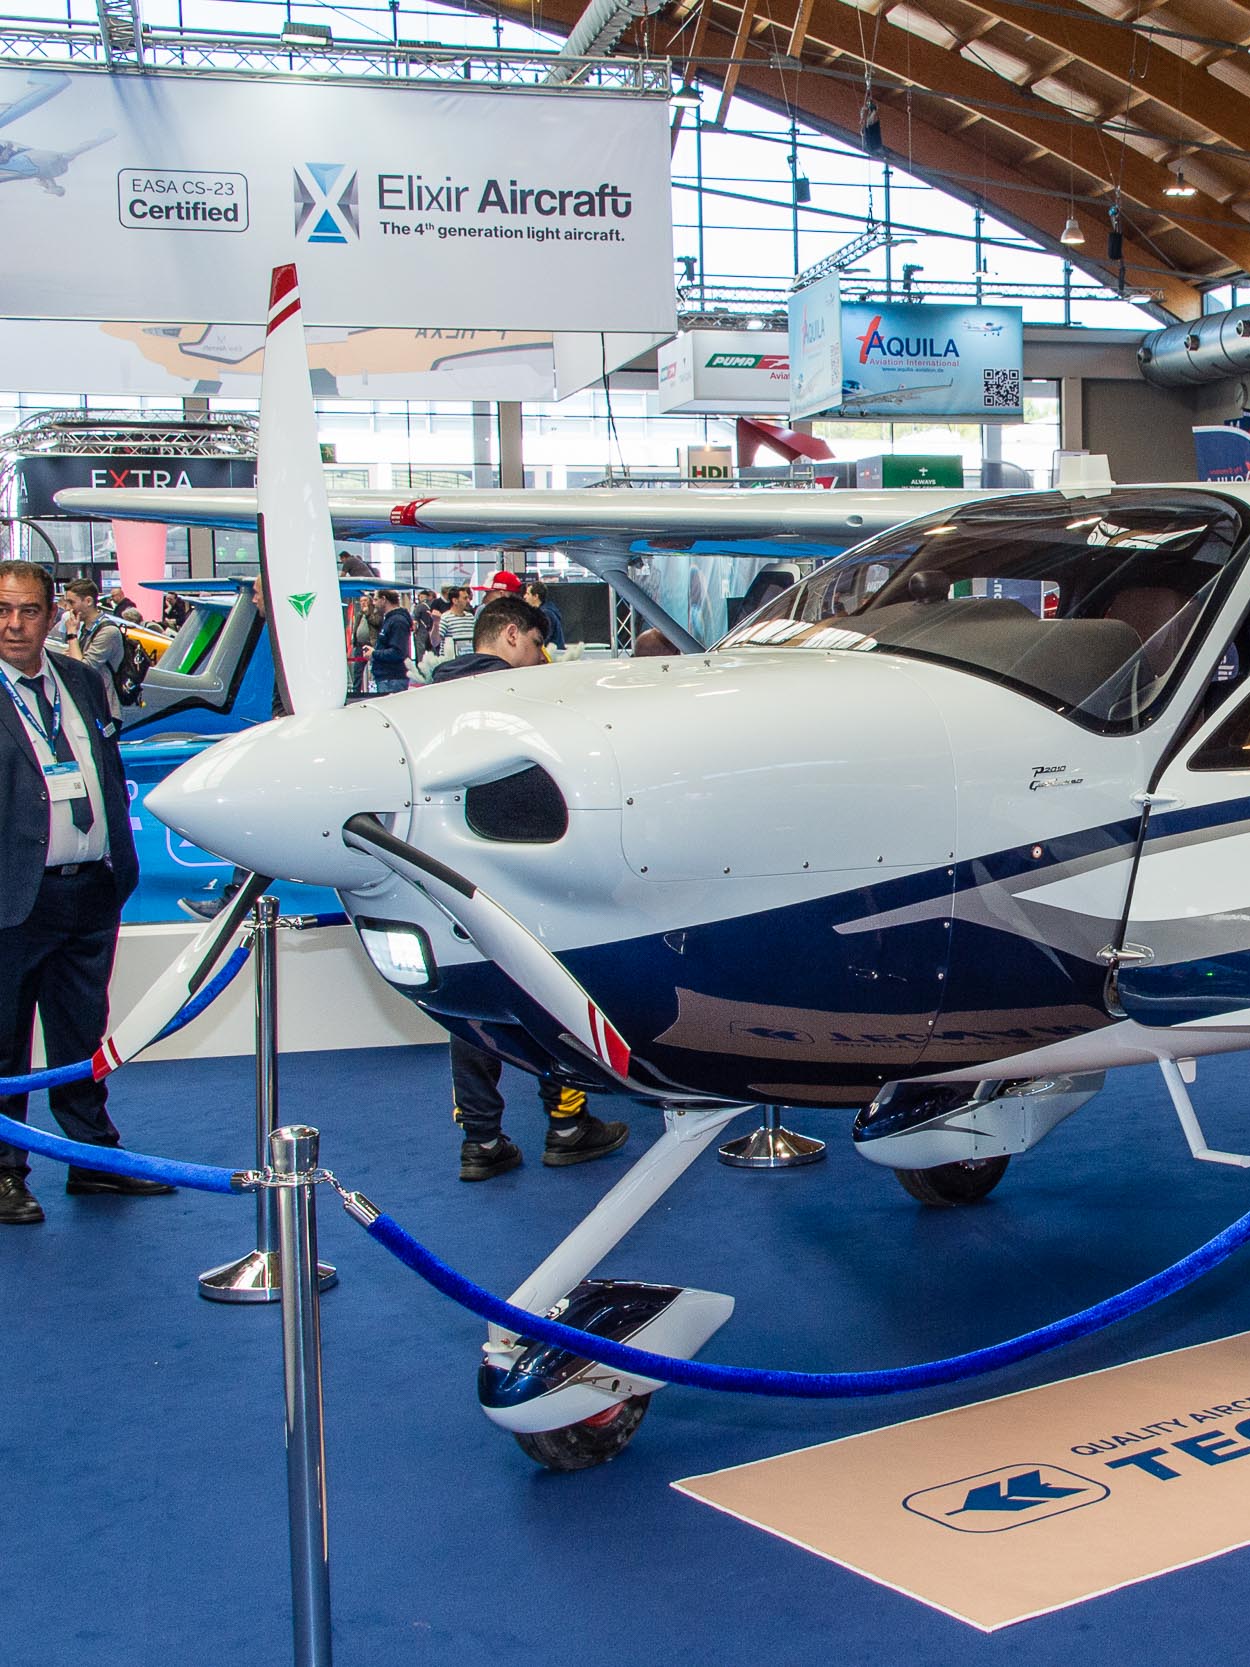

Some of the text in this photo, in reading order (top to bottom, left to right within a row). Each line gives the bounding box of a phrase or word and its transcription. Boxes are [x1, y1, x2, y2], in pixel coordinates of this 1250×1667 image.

[132, 178, 235, 196] EASA CS-23
[378, 174, 632, 218] Elixir Aircraft
[128, 198, 239, 222] Certified
[379, 221, 625, 242] The 4th generation light aircraft.
[865, 330, 960, 358] AQUILA
[712, 356, 756, 367] PUMA
[869, 357, 960, 368] Aviation International
[91, 469, 194, 488] EXTRA
[691, 465, 728, 479] HDI
[1031, 765, 1067, 778] P2010
[1070, 1418, 1190, 1456] QUALITY
